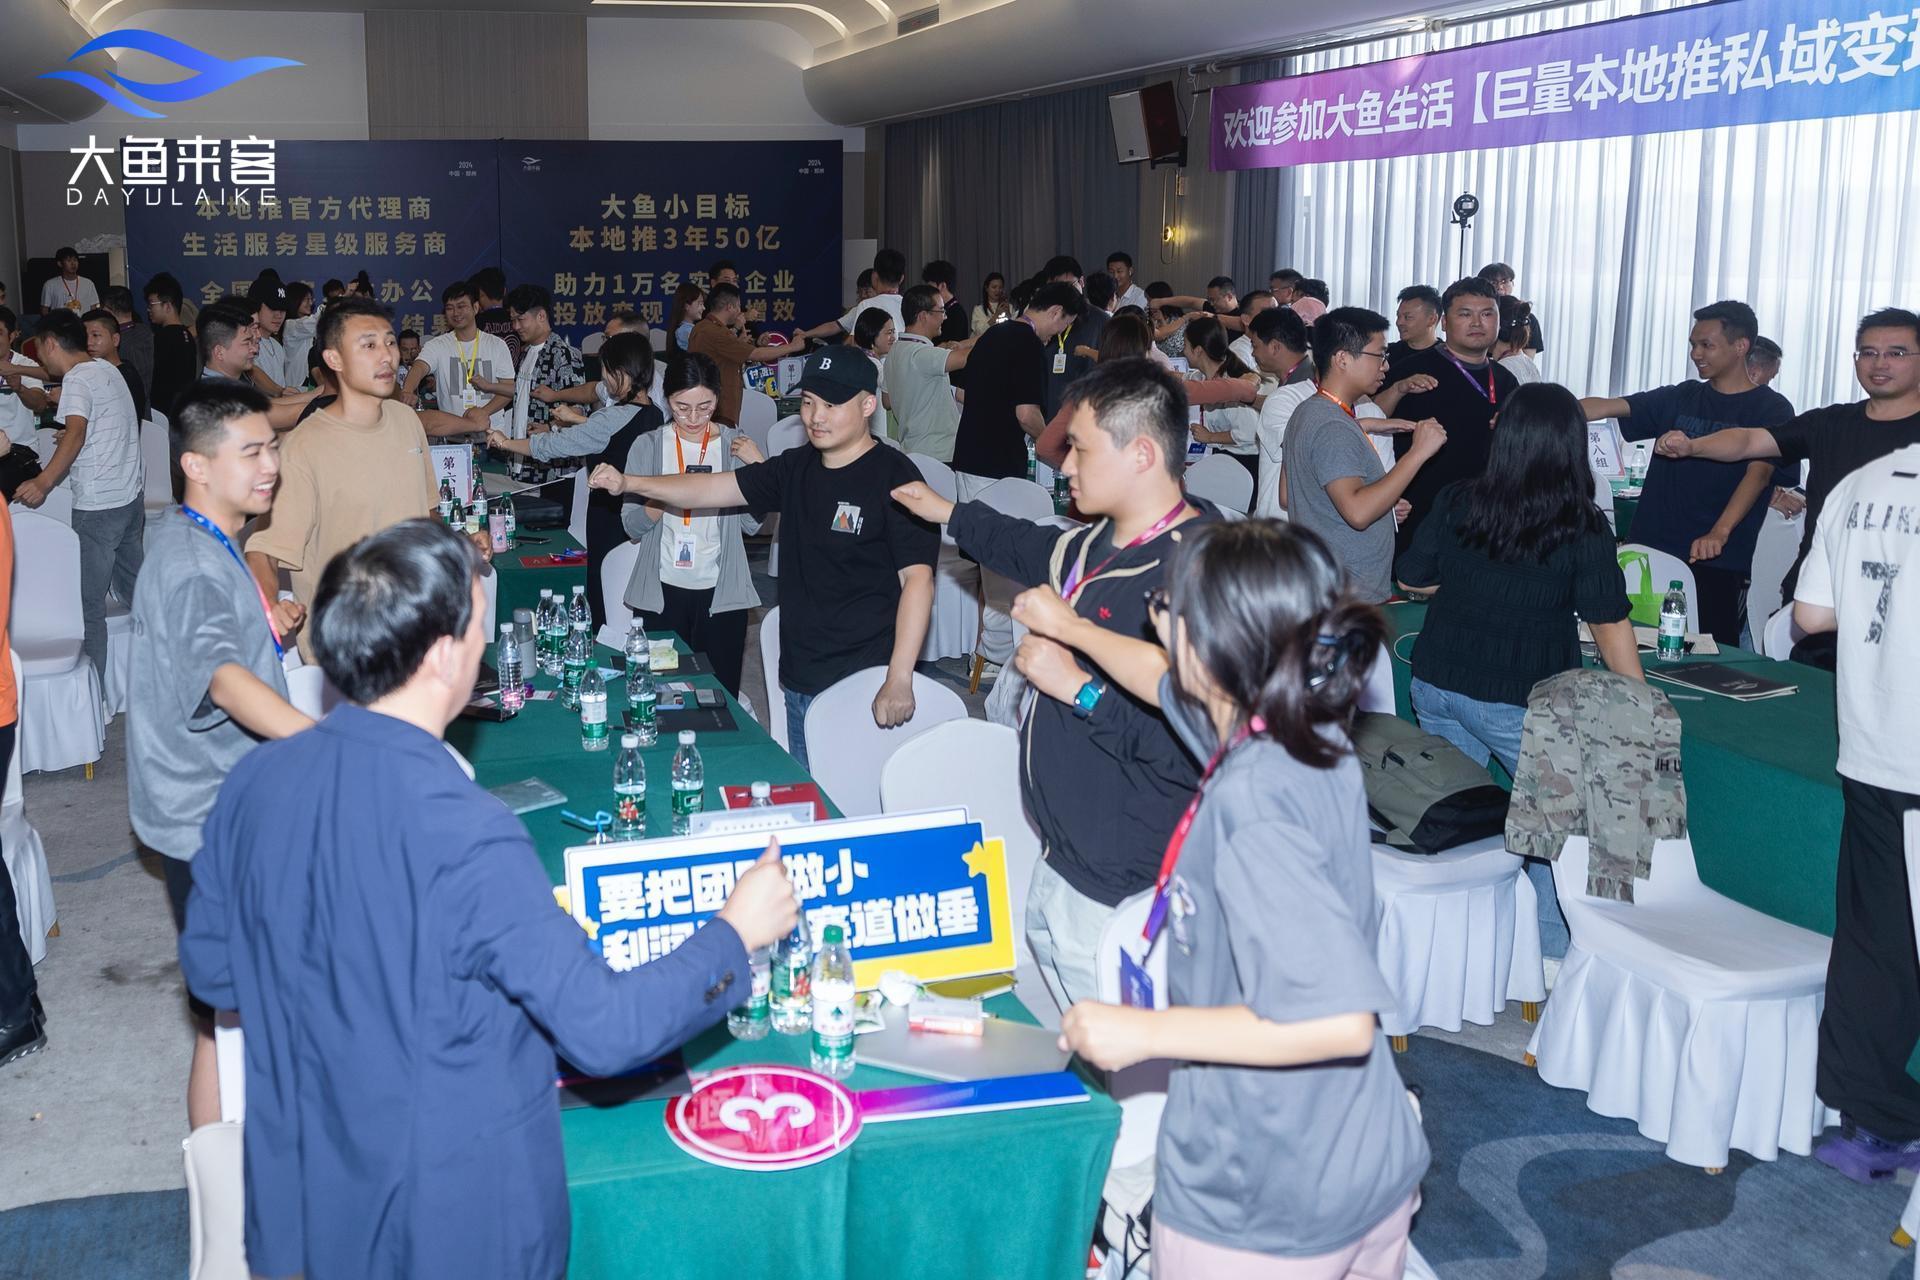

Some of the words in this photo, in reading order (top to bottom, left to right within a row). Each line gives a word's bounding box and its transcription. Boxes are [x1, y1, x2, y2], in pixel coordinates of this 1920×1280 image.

[1223, 8, 1920, 150] 欢迎参加大鱼生活【巨量本地推私域变
[196, 196, 432, 221] 本地推官方代理商
[601, 193, 750, 220] 大鱼小目标
[182, 232, 447, 257] 生活服务星级服务商
[569, 225, 781, 252] 本地推3年50亿
[553, 269, 796, 296] 助力1万名实企业
[818, 357, 832, 370] B
[1589, 431, 1609, 468] 第八组
[598, 848, 869, 925] 要把团做小
